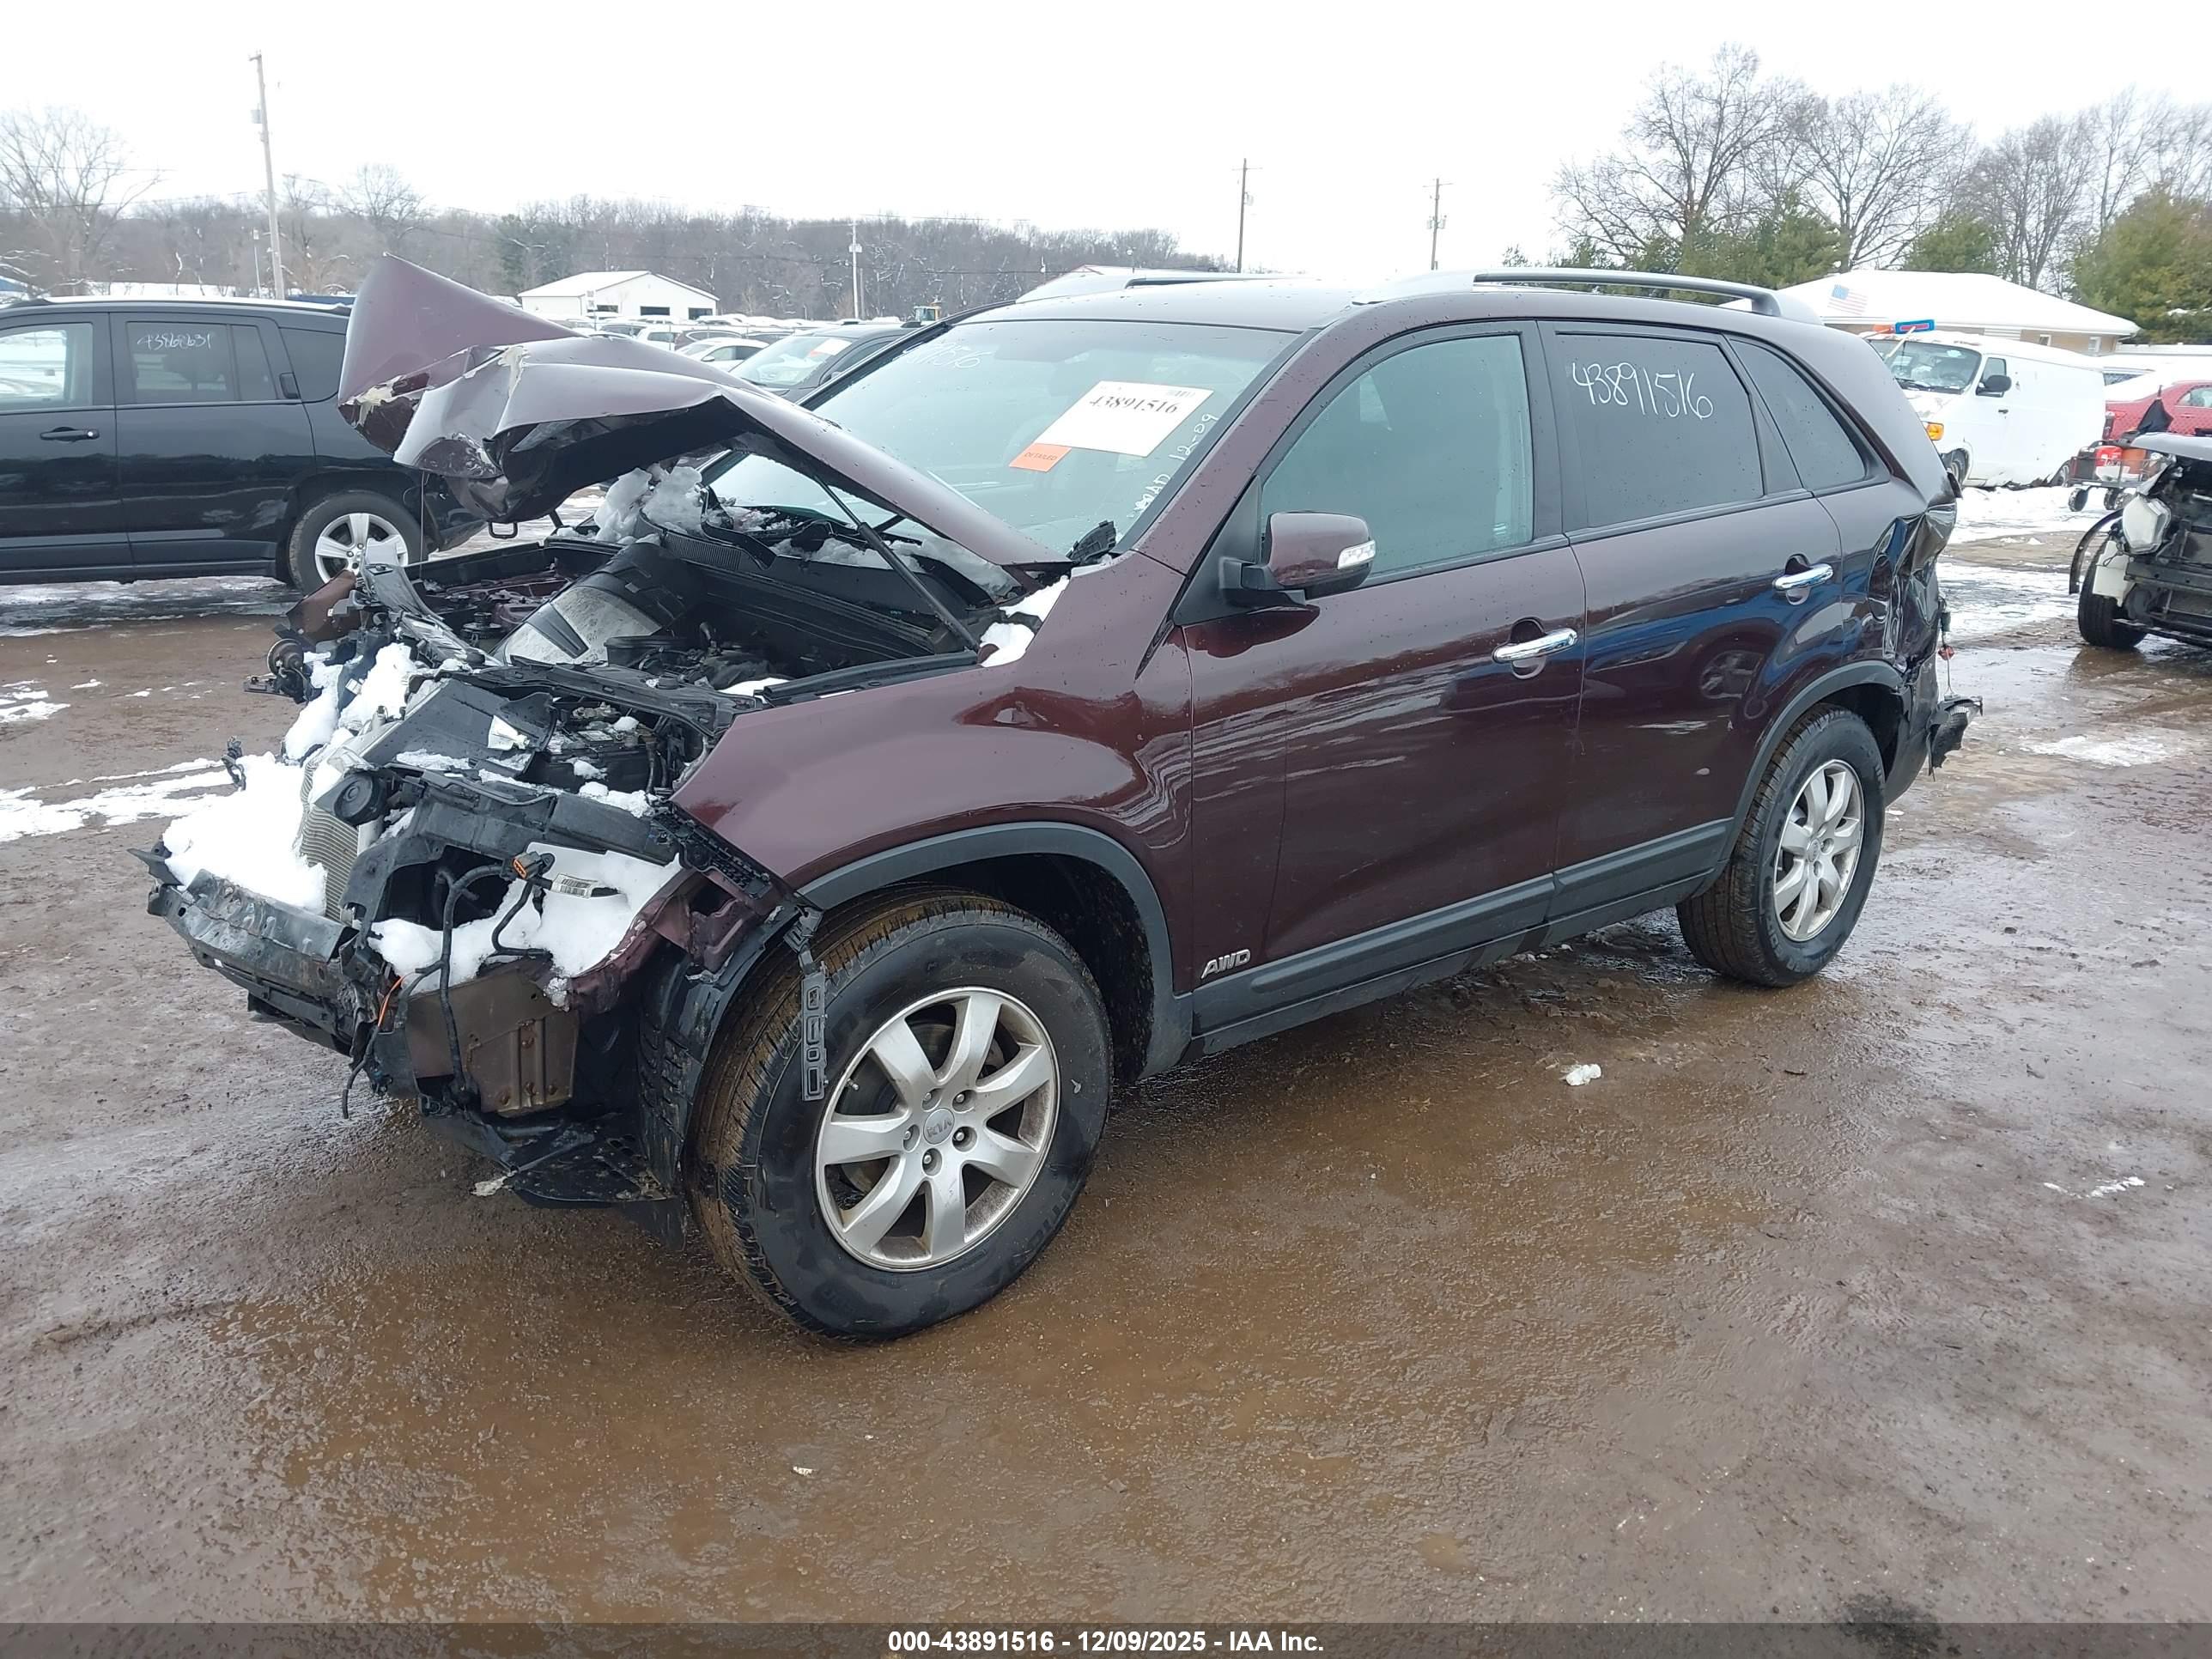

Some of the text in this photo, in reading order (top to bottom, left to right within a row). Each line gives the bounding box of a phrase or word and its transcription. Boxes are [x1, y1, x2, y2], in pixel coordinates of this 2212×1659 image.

[1089, 395, 1180, 414] 43891516
[1572, 362, 1714, 420] 43891516
[1168, 413, 1219, 461] 12-09
[1201, 948, 1251, 979] AWD
